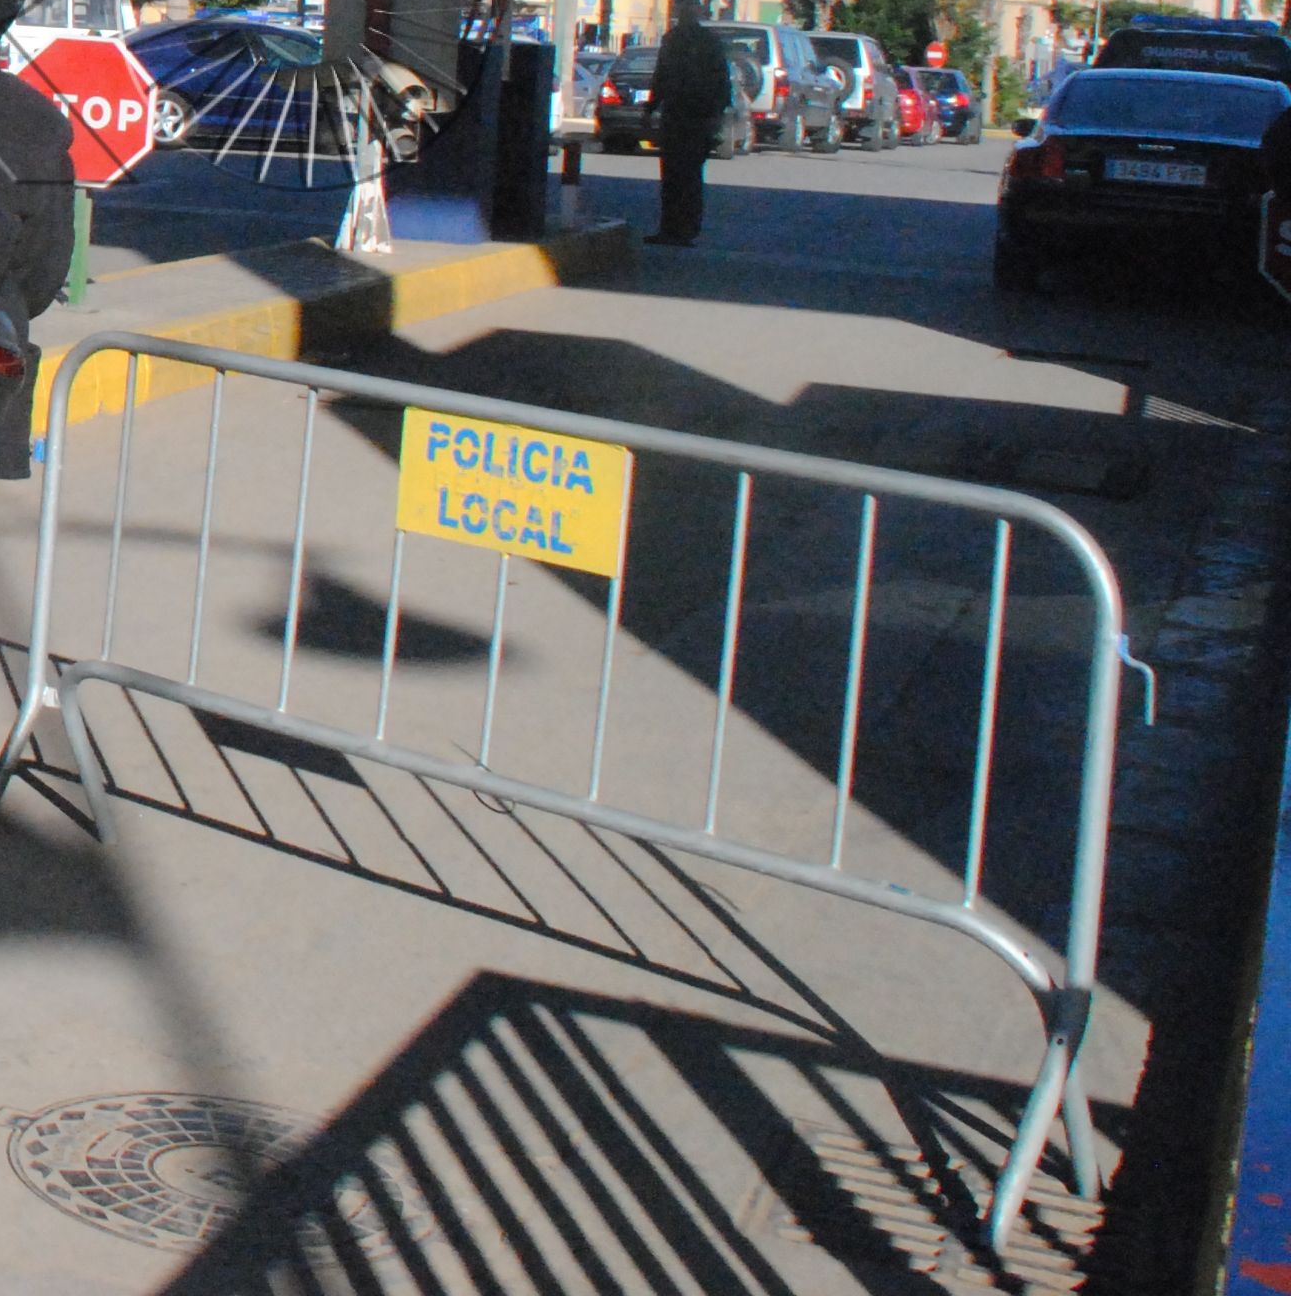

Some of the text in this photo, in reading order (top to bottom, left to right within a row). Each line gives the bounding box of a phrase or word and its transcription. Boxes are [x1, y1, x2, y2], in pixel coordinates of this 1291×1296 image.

[52, 92, 144, 133] TOP
[426, 421, 594, 495] POLICIA
[438, 486, 573, 554] LOCAL
